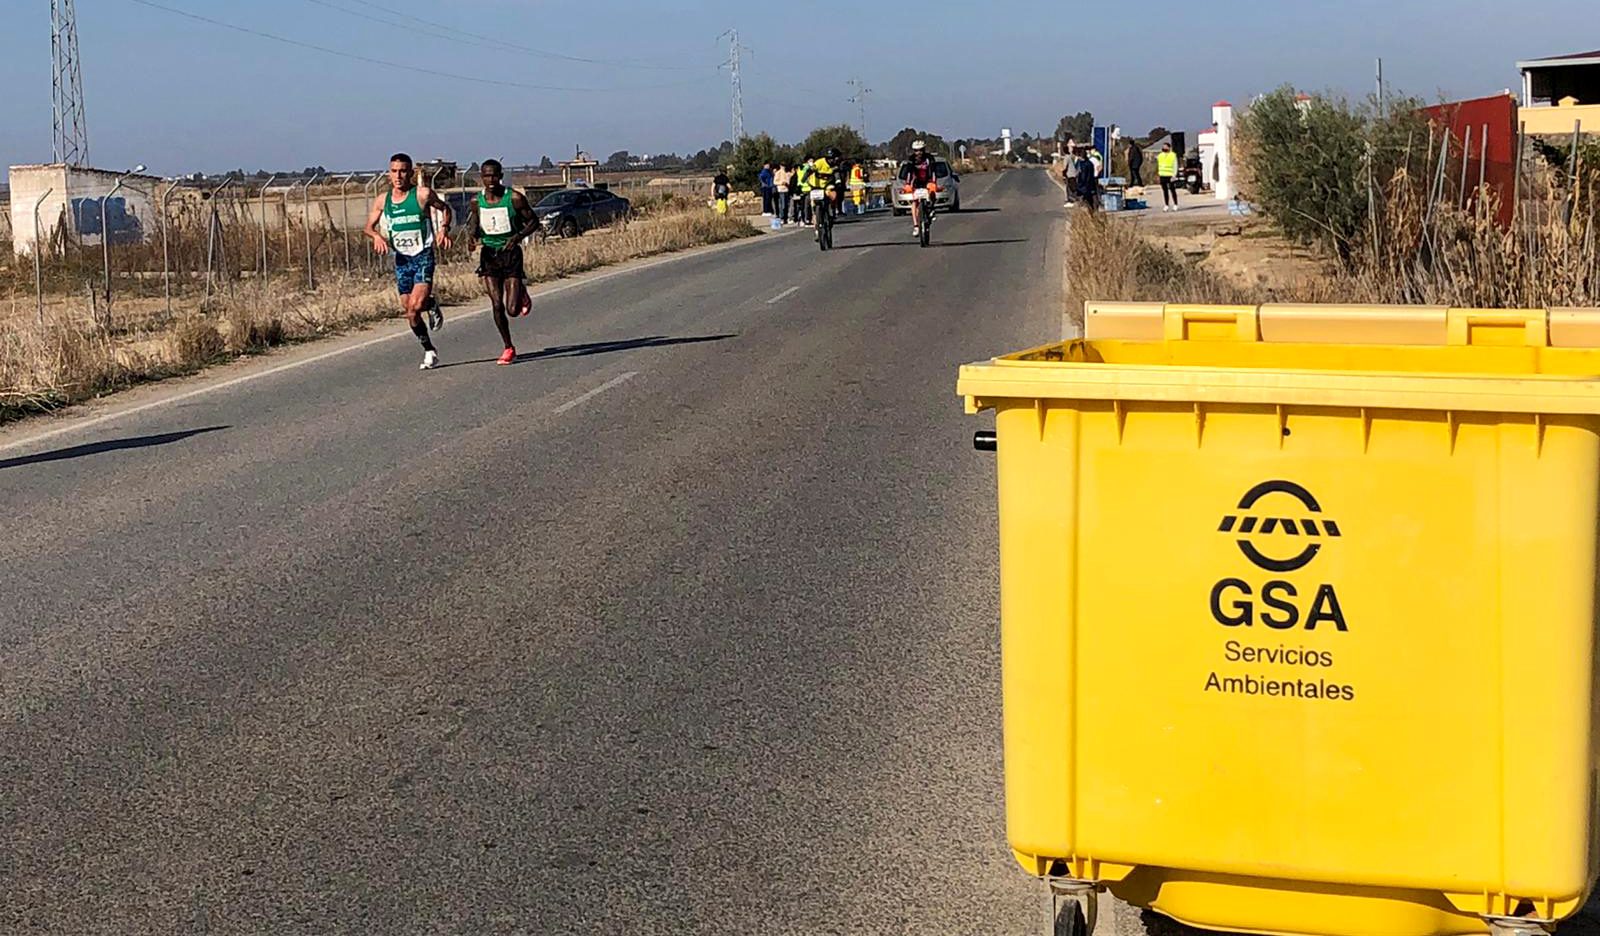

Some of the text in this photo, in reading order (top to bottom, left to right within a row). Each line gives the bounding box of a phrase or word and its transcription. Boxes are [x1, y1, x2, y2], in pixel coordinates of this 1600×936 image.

[395, 236, 420, 247] 2231
[1210, 577, 1348, 632] GSA
[1225, 640, 1333, 667] Servicios
[1204, 672, 1355, 701] Ambientales
